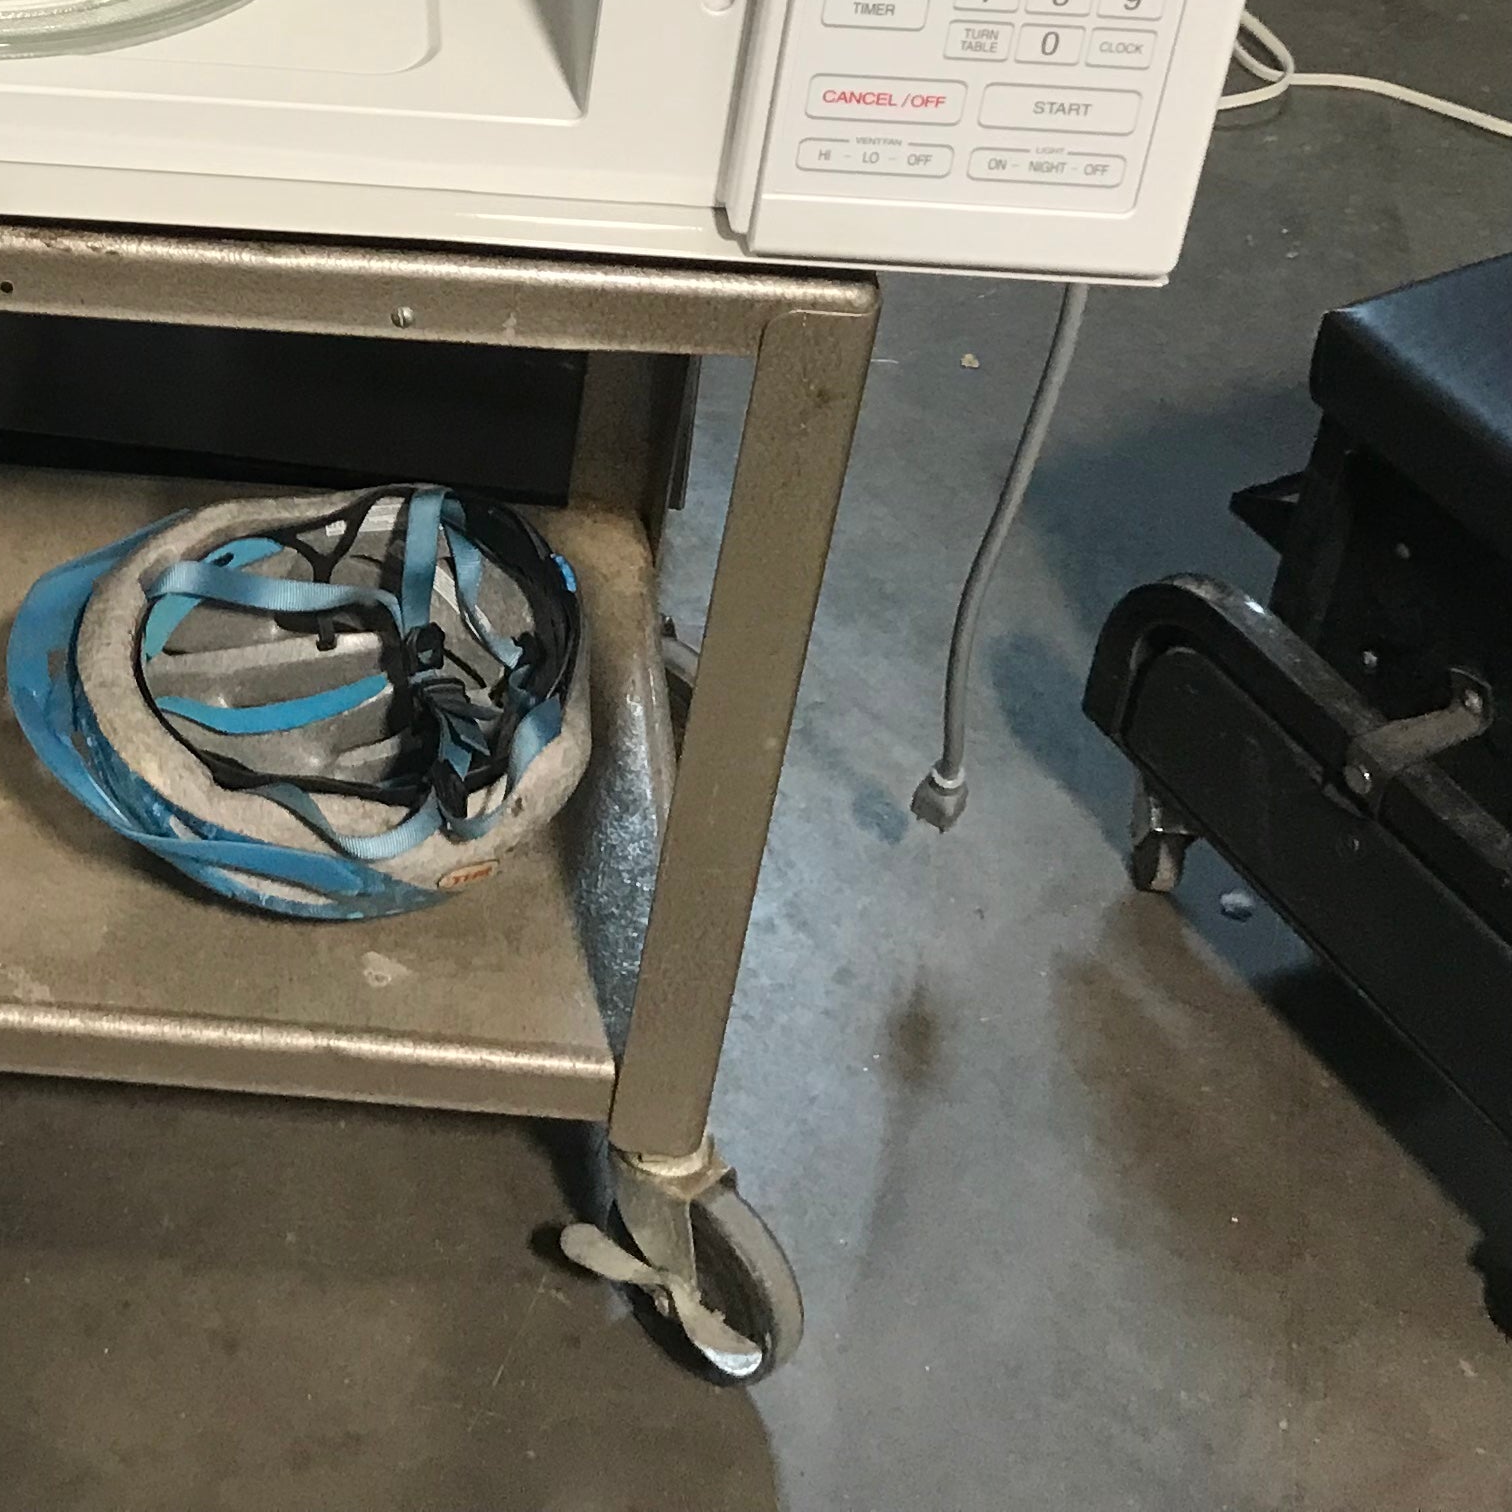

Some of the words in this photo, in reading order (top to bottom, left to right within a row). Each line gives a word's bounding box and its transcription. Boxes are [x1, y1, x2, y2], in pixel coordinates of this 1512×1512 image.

[853, 2, 895, 17] TIMER
[964, 28, 999, 41] TURN
[960, 40, 998, 54] TABLE
[1041, 31, 1059, 56] 0
[1099, 41, 1143, 55] CLOCK
[1033, 101, 1093, 117] START
[818, 149, 831, 162] HI
[863, 151, 879, 164] LO
[907, 153, 933, 167] OFF
[988, 158, 1006, 171] ON
[1029, 160, 1066, 174] NIGHT
[1084, 163, 1109, 176] OFF
